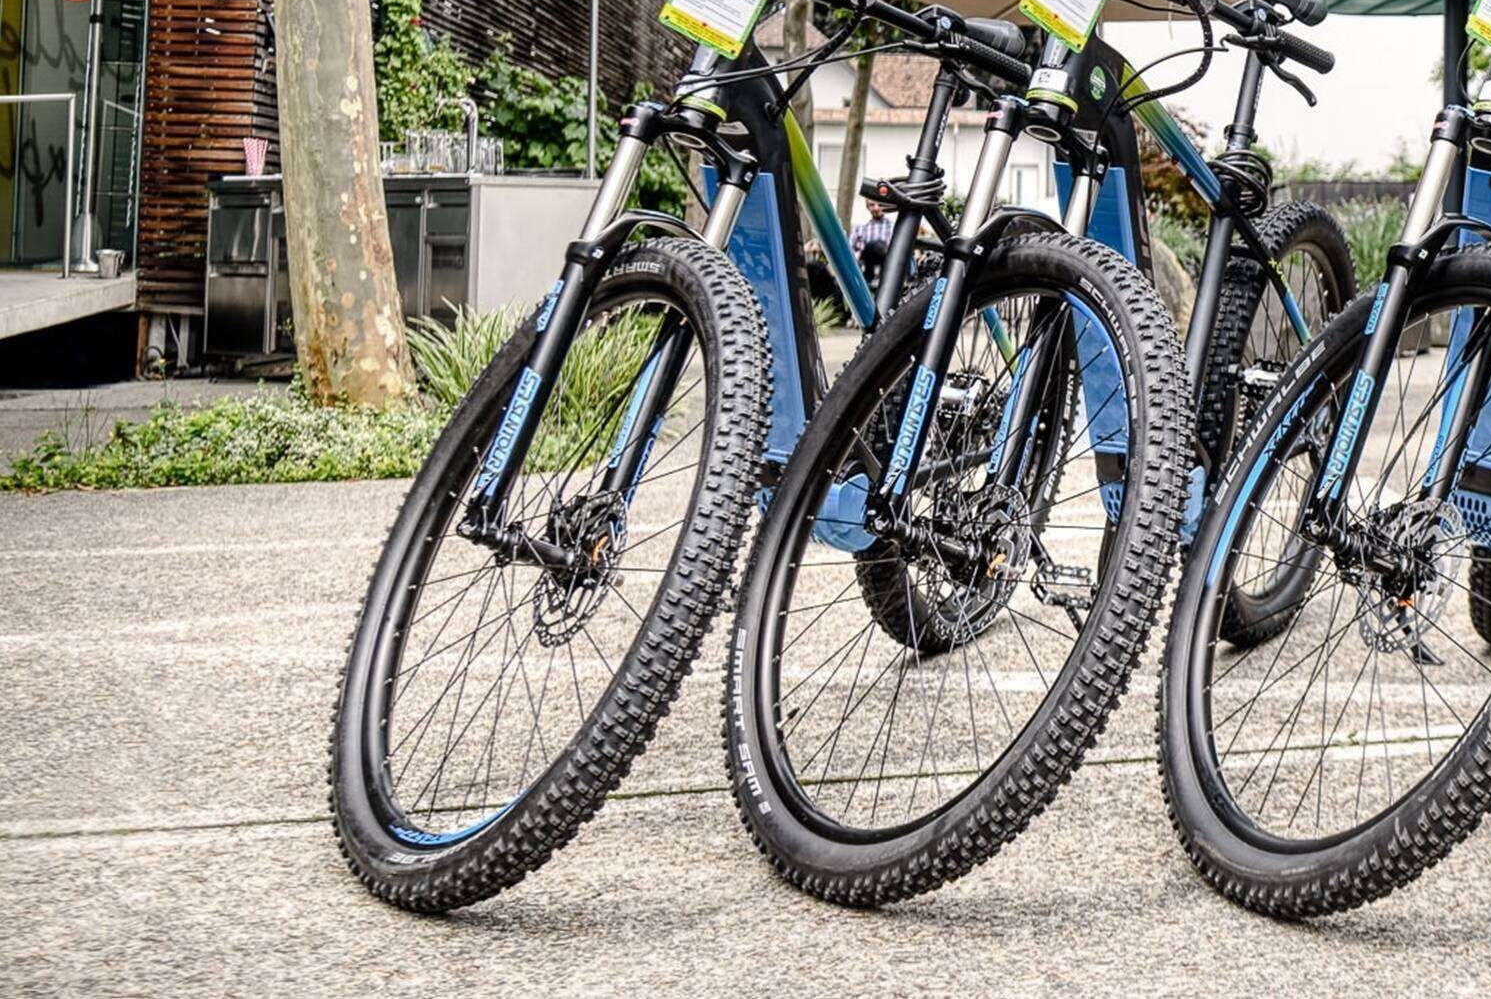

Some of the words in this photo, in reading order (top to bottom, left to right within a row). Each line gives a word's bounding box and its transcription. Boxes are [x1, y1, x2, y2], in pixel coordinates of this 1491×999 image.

[488, 397, 526, 468] SUNTOUR
[892, 400, 925, 471] SUNTOUR
[1214, 339, 1327, 505] SCHWALBE
[1329, 405, 1362, 473] SUNTOUR
[733, 627, 749, 731] SMART
[737, 742, 763, 799] SAM
